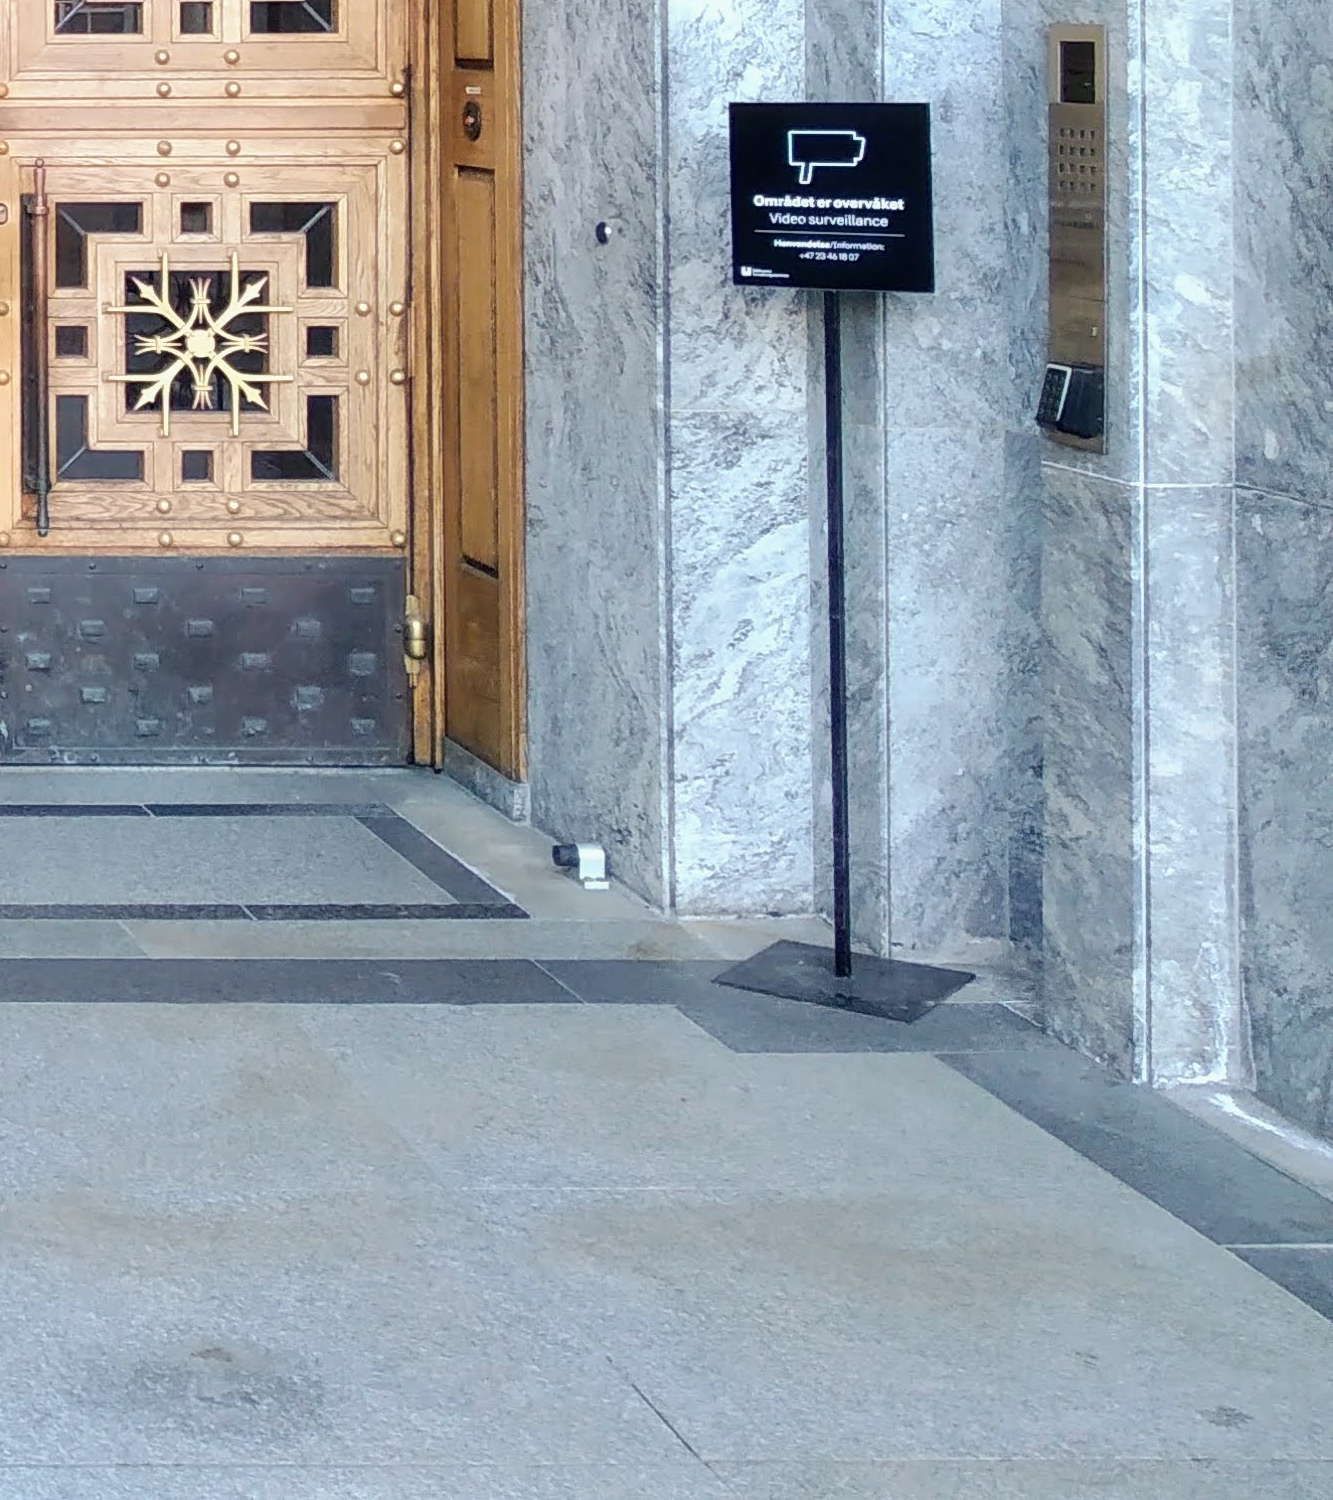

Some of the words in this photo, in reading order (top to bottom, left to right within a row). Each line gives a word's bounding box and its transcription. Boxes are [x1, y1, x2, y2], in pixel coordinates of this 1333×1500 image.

[753, 195, 815, 208] Området
[816, 199, 832, 208] er
[833, 197, 904, 210] overvåket
[769, 213, 806, 224] Video
[808, 214, 888, 227] surveillance
[827, 252, 838, 260] 46
